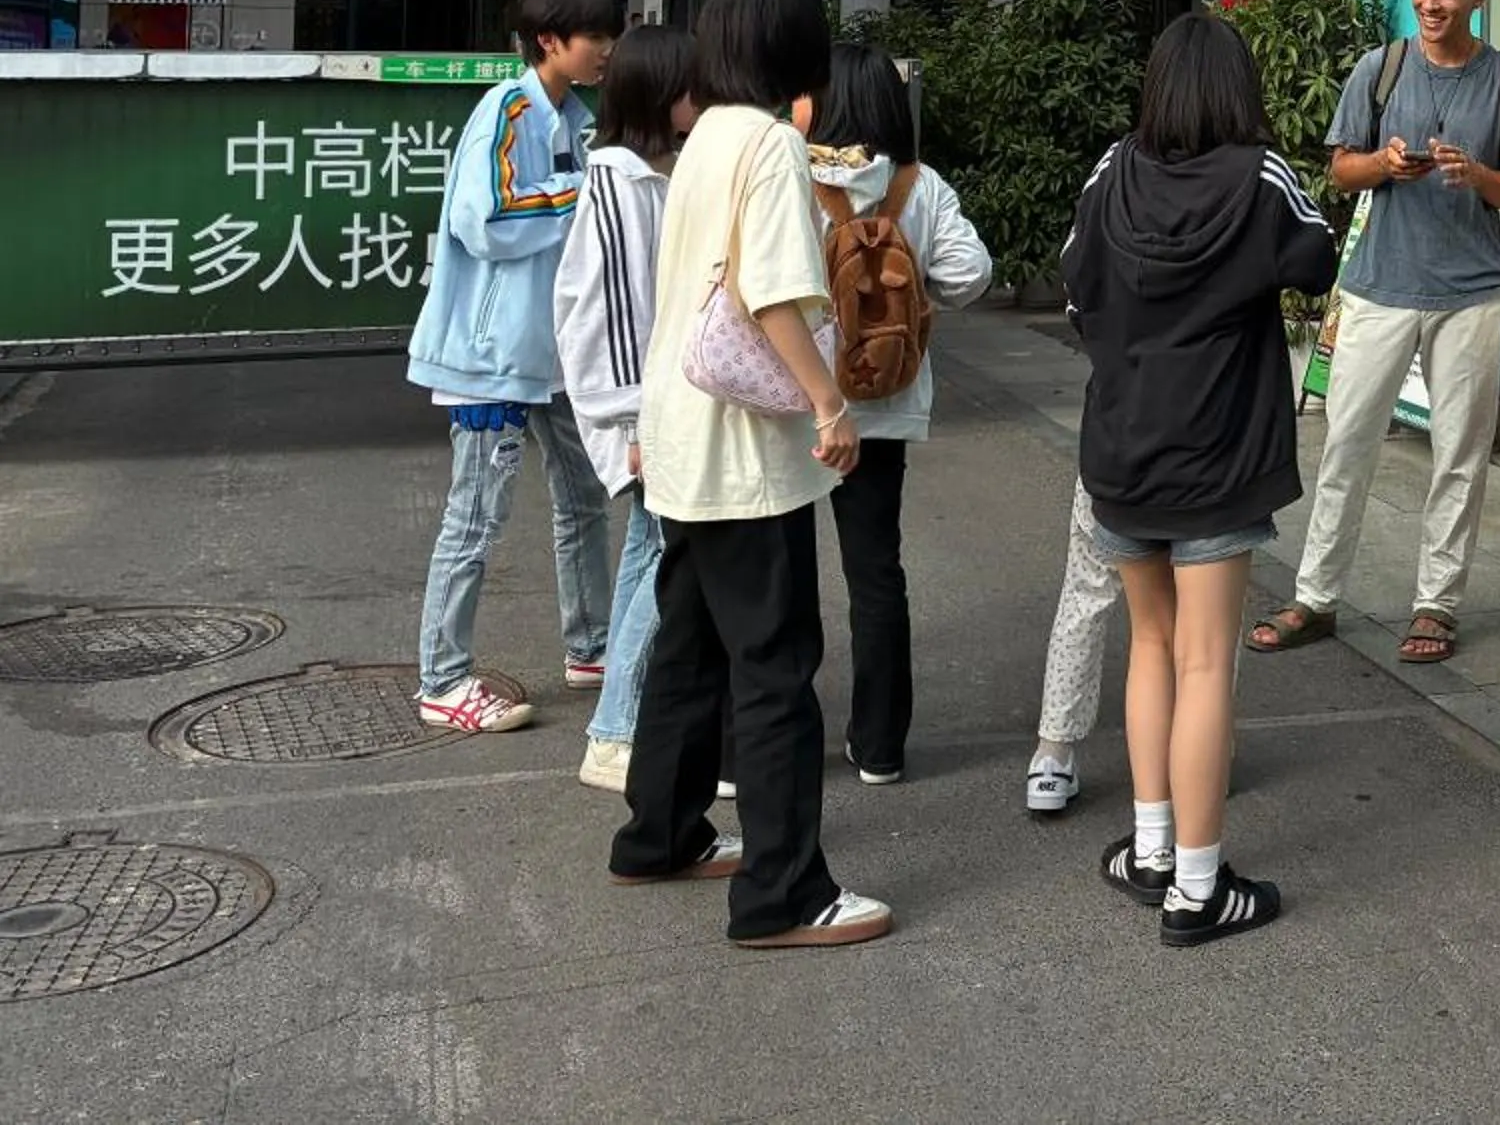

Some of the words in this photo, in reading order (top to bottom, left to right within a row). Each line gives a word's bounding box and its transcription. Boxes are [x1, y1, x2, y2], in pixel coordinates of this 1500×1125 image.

[225, 120, 453, 201] 中高档
[101, 212, 434, 298] 更多人找
